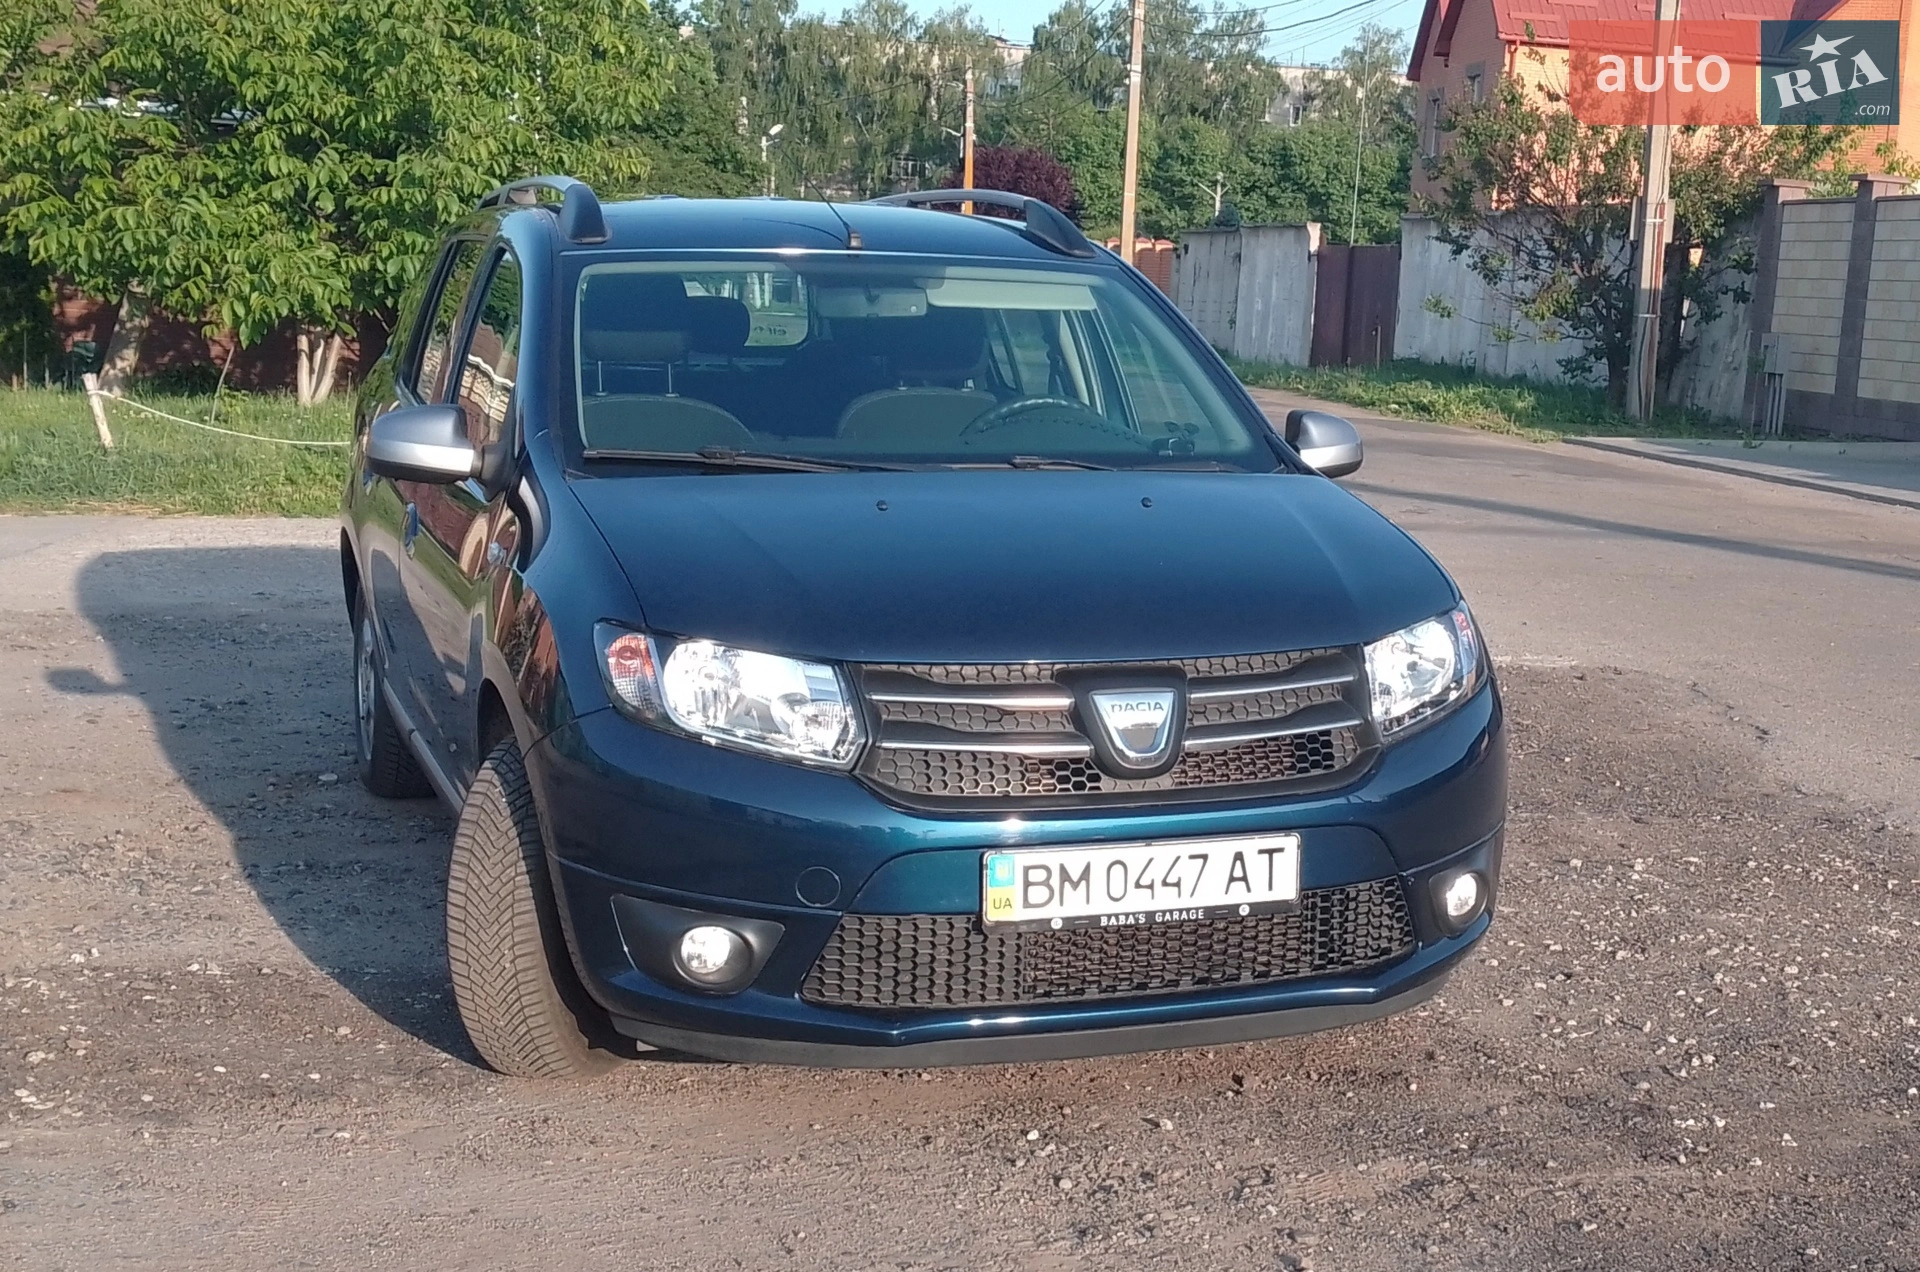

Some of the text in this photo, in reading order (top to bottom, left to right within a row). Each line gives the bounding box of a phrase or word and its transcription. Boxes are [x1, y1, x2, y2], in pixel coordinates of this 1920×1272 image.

[1110, 701, 1165, 713] DACIA
[1022, 848, 1286, 909] BM 0447 AT
[993, 897, 1013, 910] UA
[1100, 909, 1205, 927] BABA'S GARAGE
